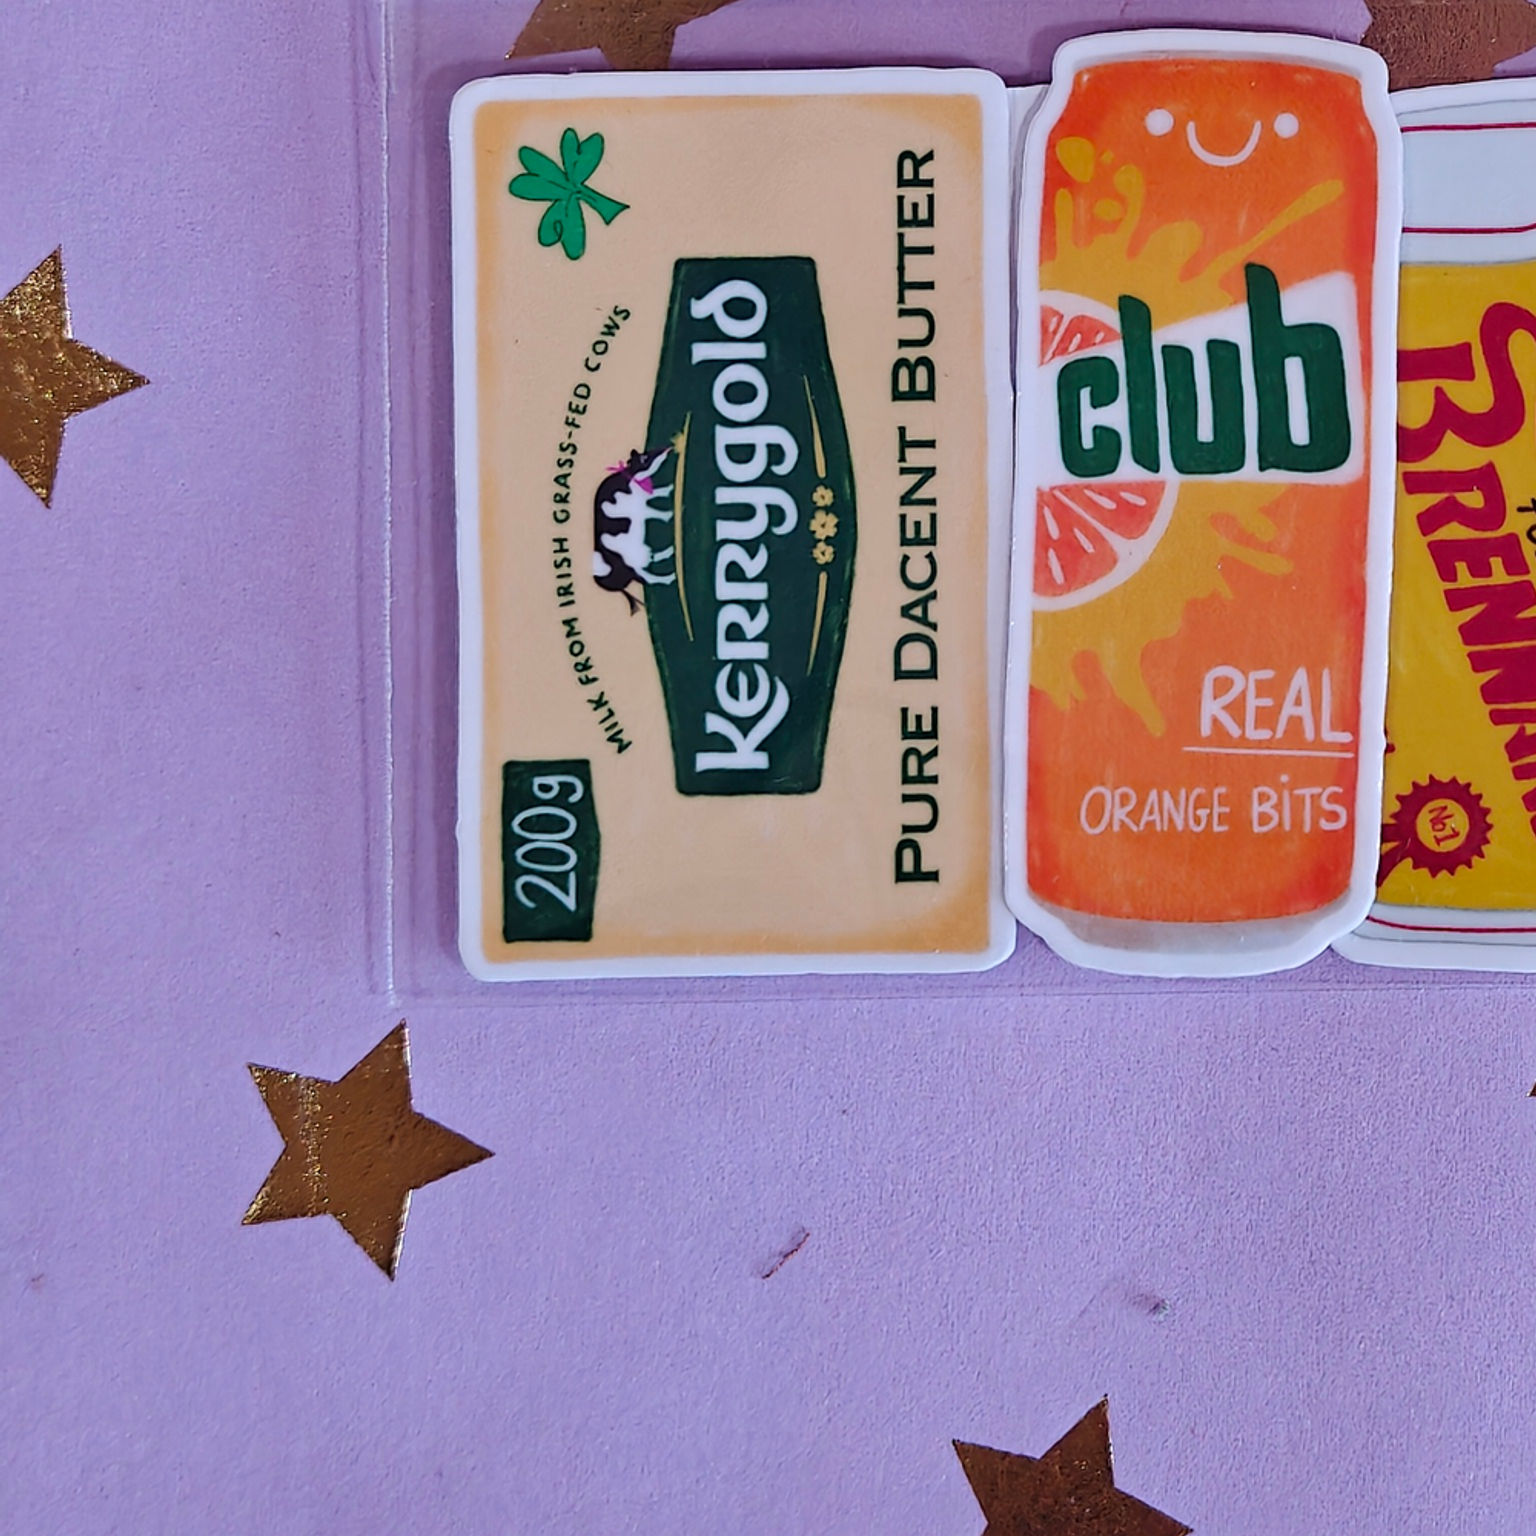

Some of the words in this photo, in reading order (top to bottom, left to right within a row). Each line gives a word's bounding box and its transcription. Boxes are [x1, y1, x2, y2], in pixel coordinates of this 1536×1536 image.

[584, 304, 632, 373] COWS
[1056, 262, 1352, 479] club
[552, 381, 592, 525] GRASS-FED
[552, 536, 576, 608] IRISH
[560, 616, 601, 686] FROM
[586, 690, 633, 755] MILK
[1199, 664, 1353, 746] REAL
[514, 773, 585, 913] 200g
[1079, 784, 1230, 834] ORANGE
